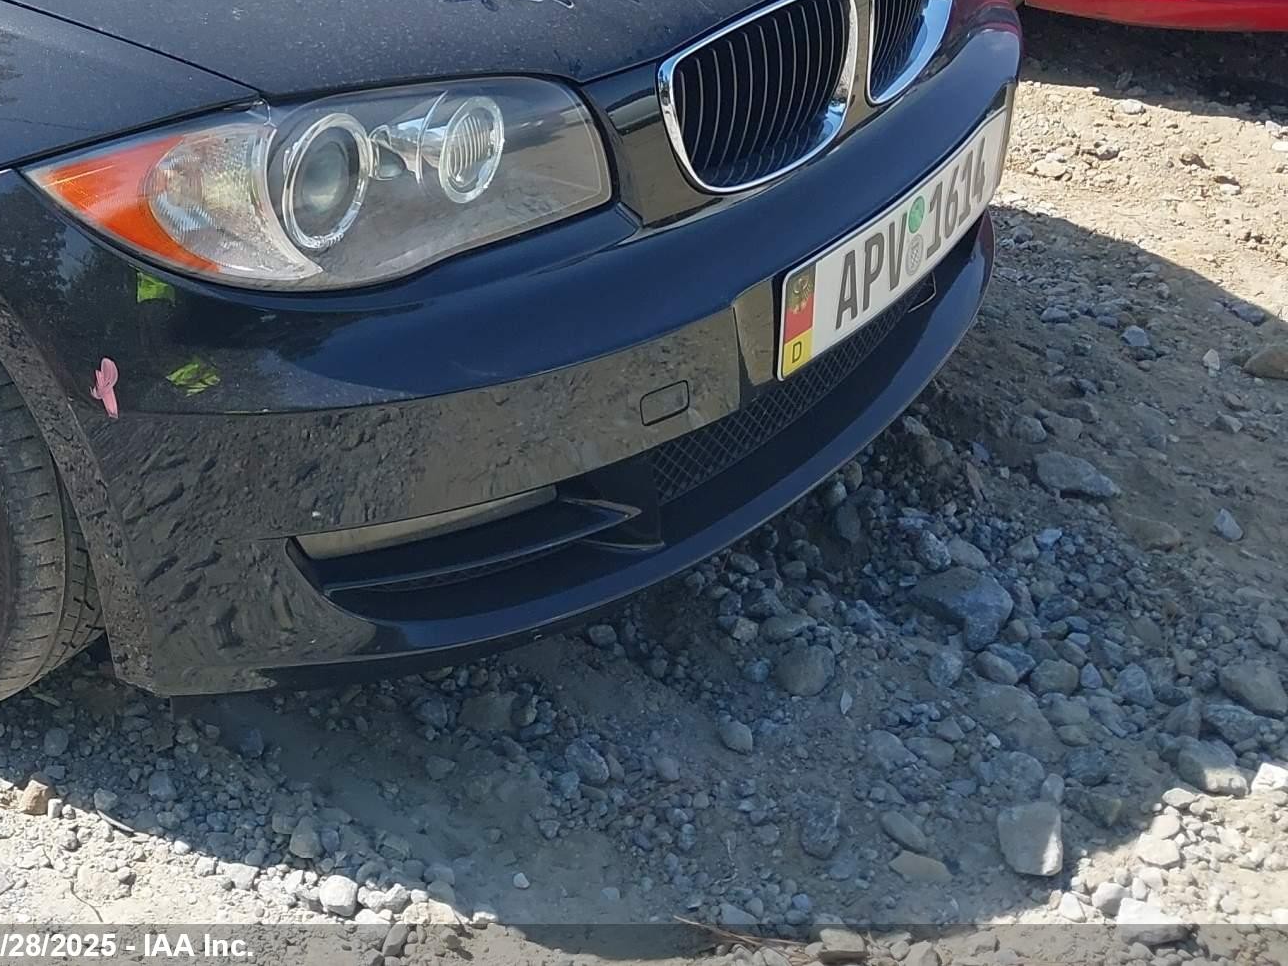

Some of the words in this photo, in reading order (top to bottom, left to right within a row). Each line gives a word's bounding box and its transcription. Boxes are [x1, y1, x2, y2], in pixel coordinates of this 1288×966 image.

[835, 213, 908, 330] APV
[925, 137, 986, 260] 1614
[791, 341, 803, 364] D
